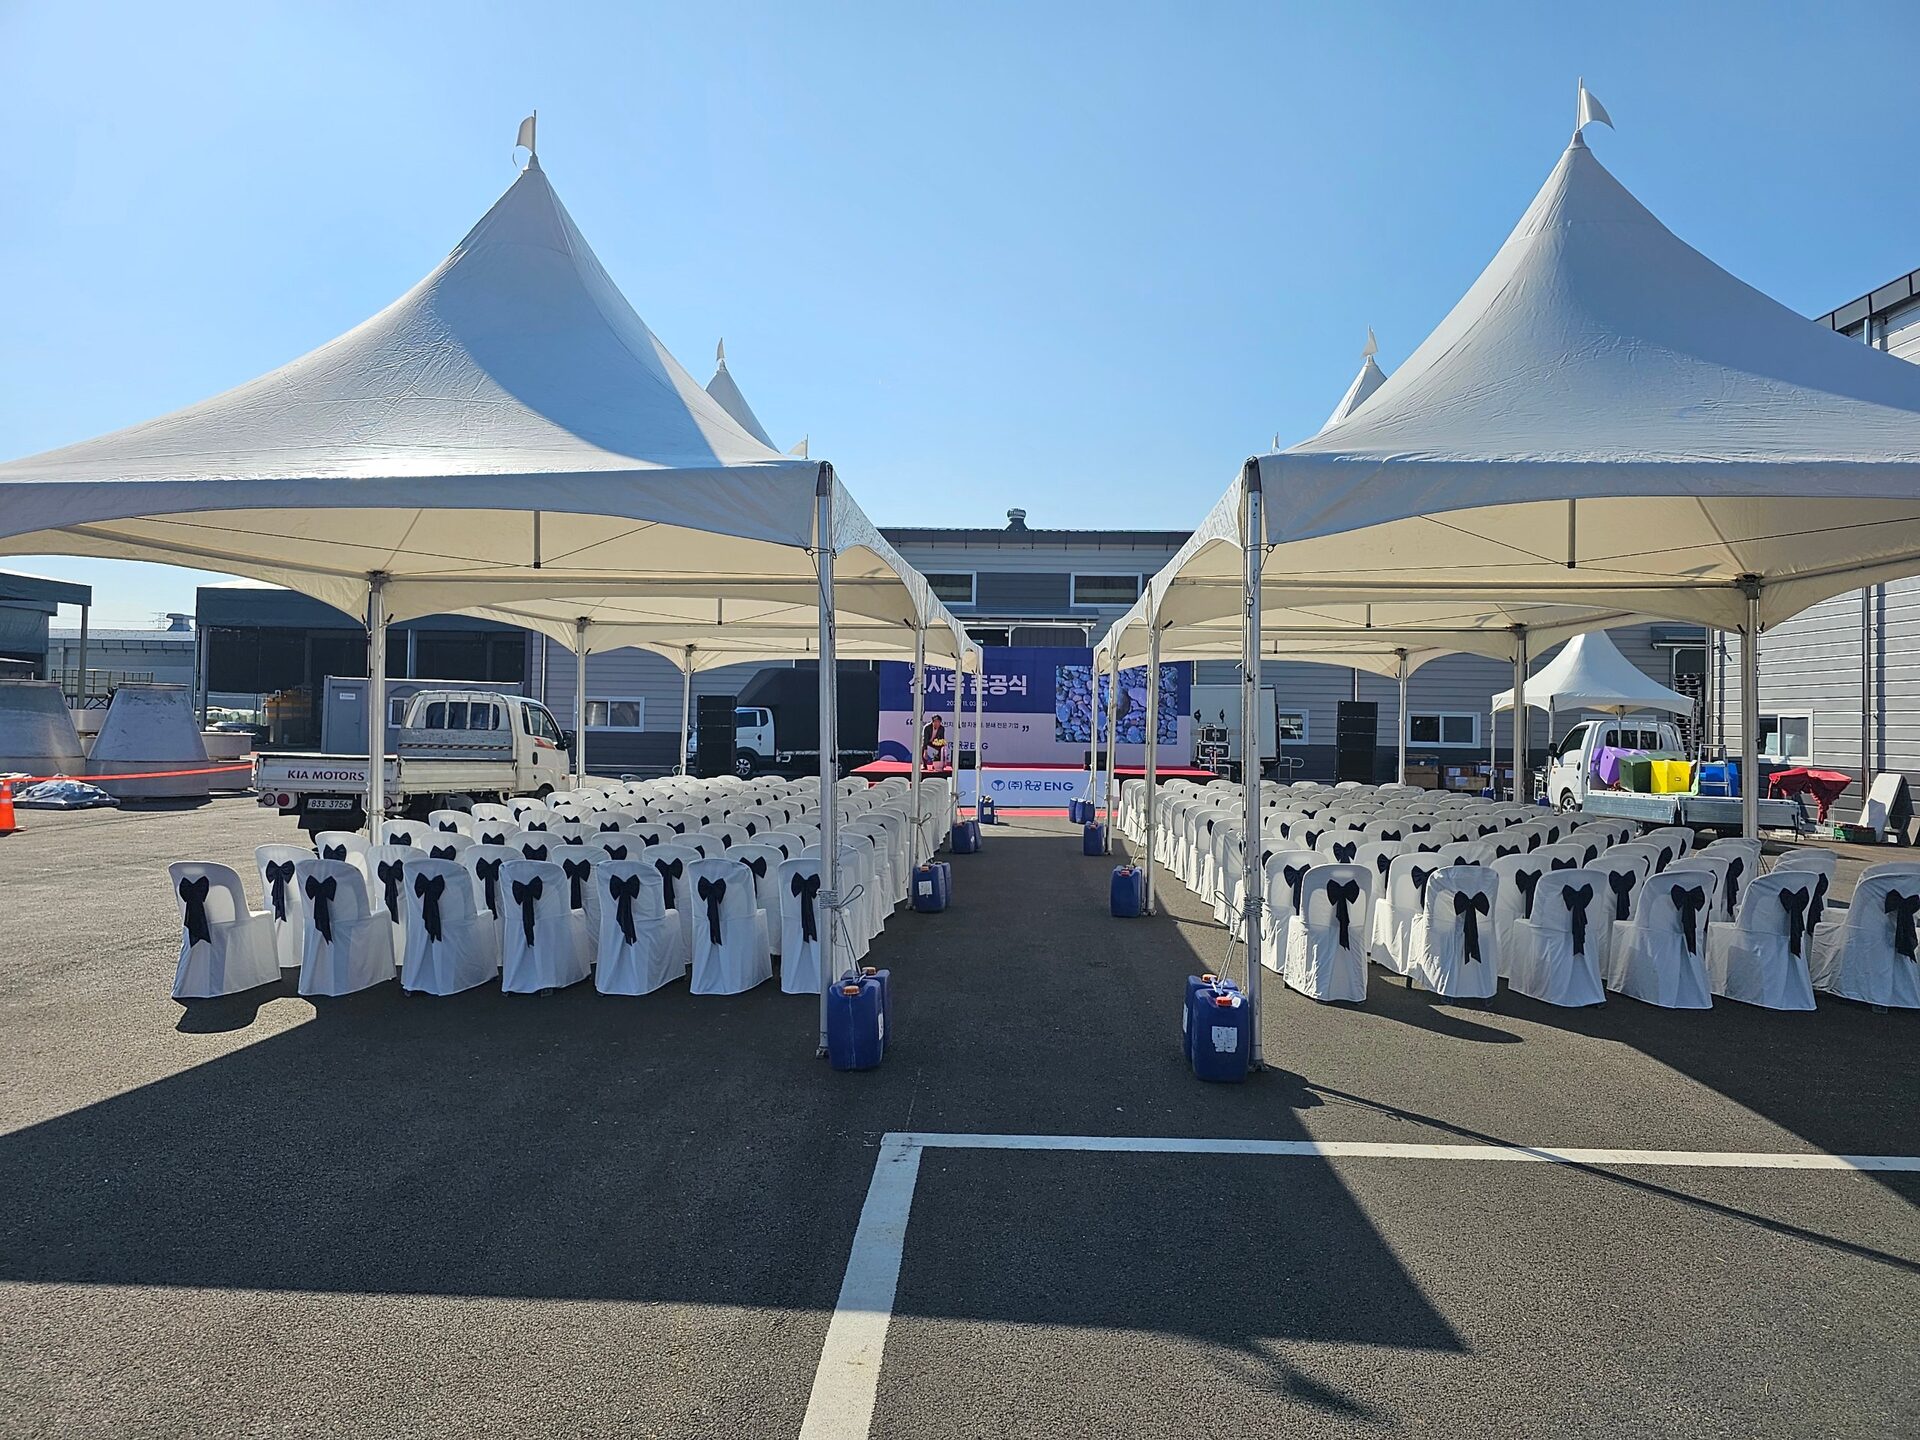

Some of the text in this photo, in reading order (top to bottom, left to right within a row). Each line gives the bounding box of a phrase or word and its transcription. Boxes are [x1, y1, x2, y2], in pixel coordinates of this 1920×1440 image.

[969, 674, 1027, 696] 준공식
[287, 769, 365, 781] KIA MOTORS
[328, 800, 349, 809] 3756
